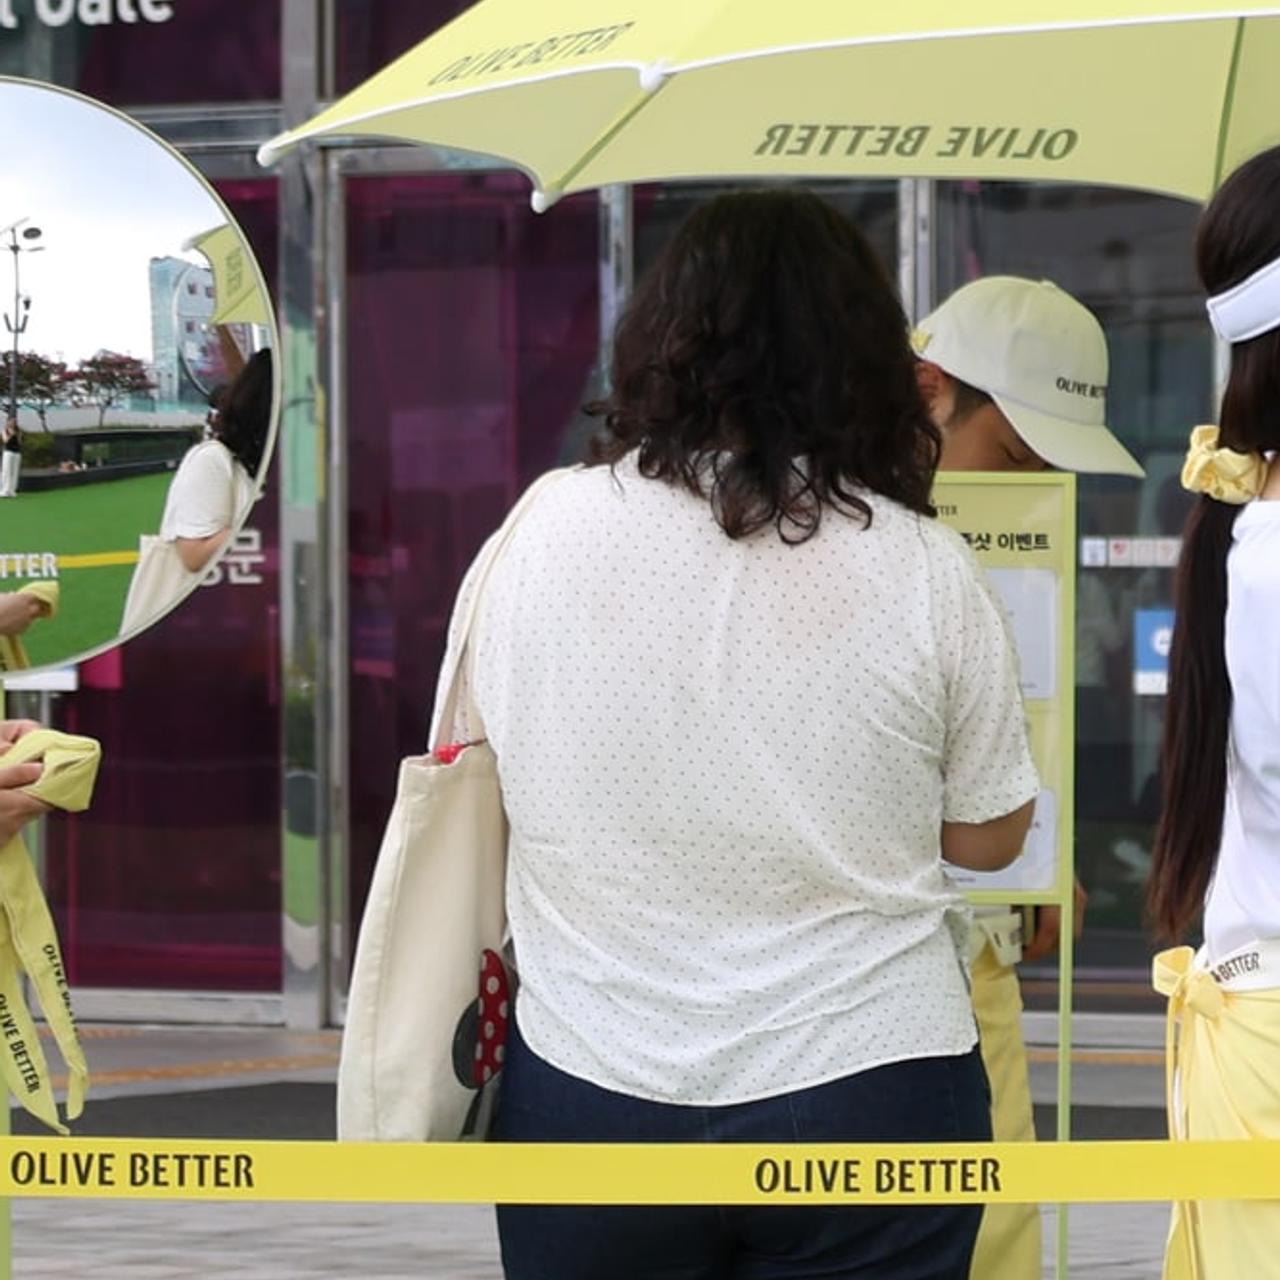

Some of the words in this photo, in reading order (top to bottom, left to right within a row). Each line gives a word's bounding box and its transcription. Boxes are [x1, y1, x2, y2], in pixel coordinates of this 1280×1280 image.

[428, 42, 536, 86] OLIVE
[512, 21, 636, 69] BETTER
[997, 532, 1050, 551] 이벤트
[9, 1039, 41, 1094] BETTER
[10, 1150, 116, 1186] OLIVE
[130, 1152, 254, 1188] BETTER
[754, 1158, 862, 1194] OLIVE
[875, 1158, 1002, 1194] BETTER
